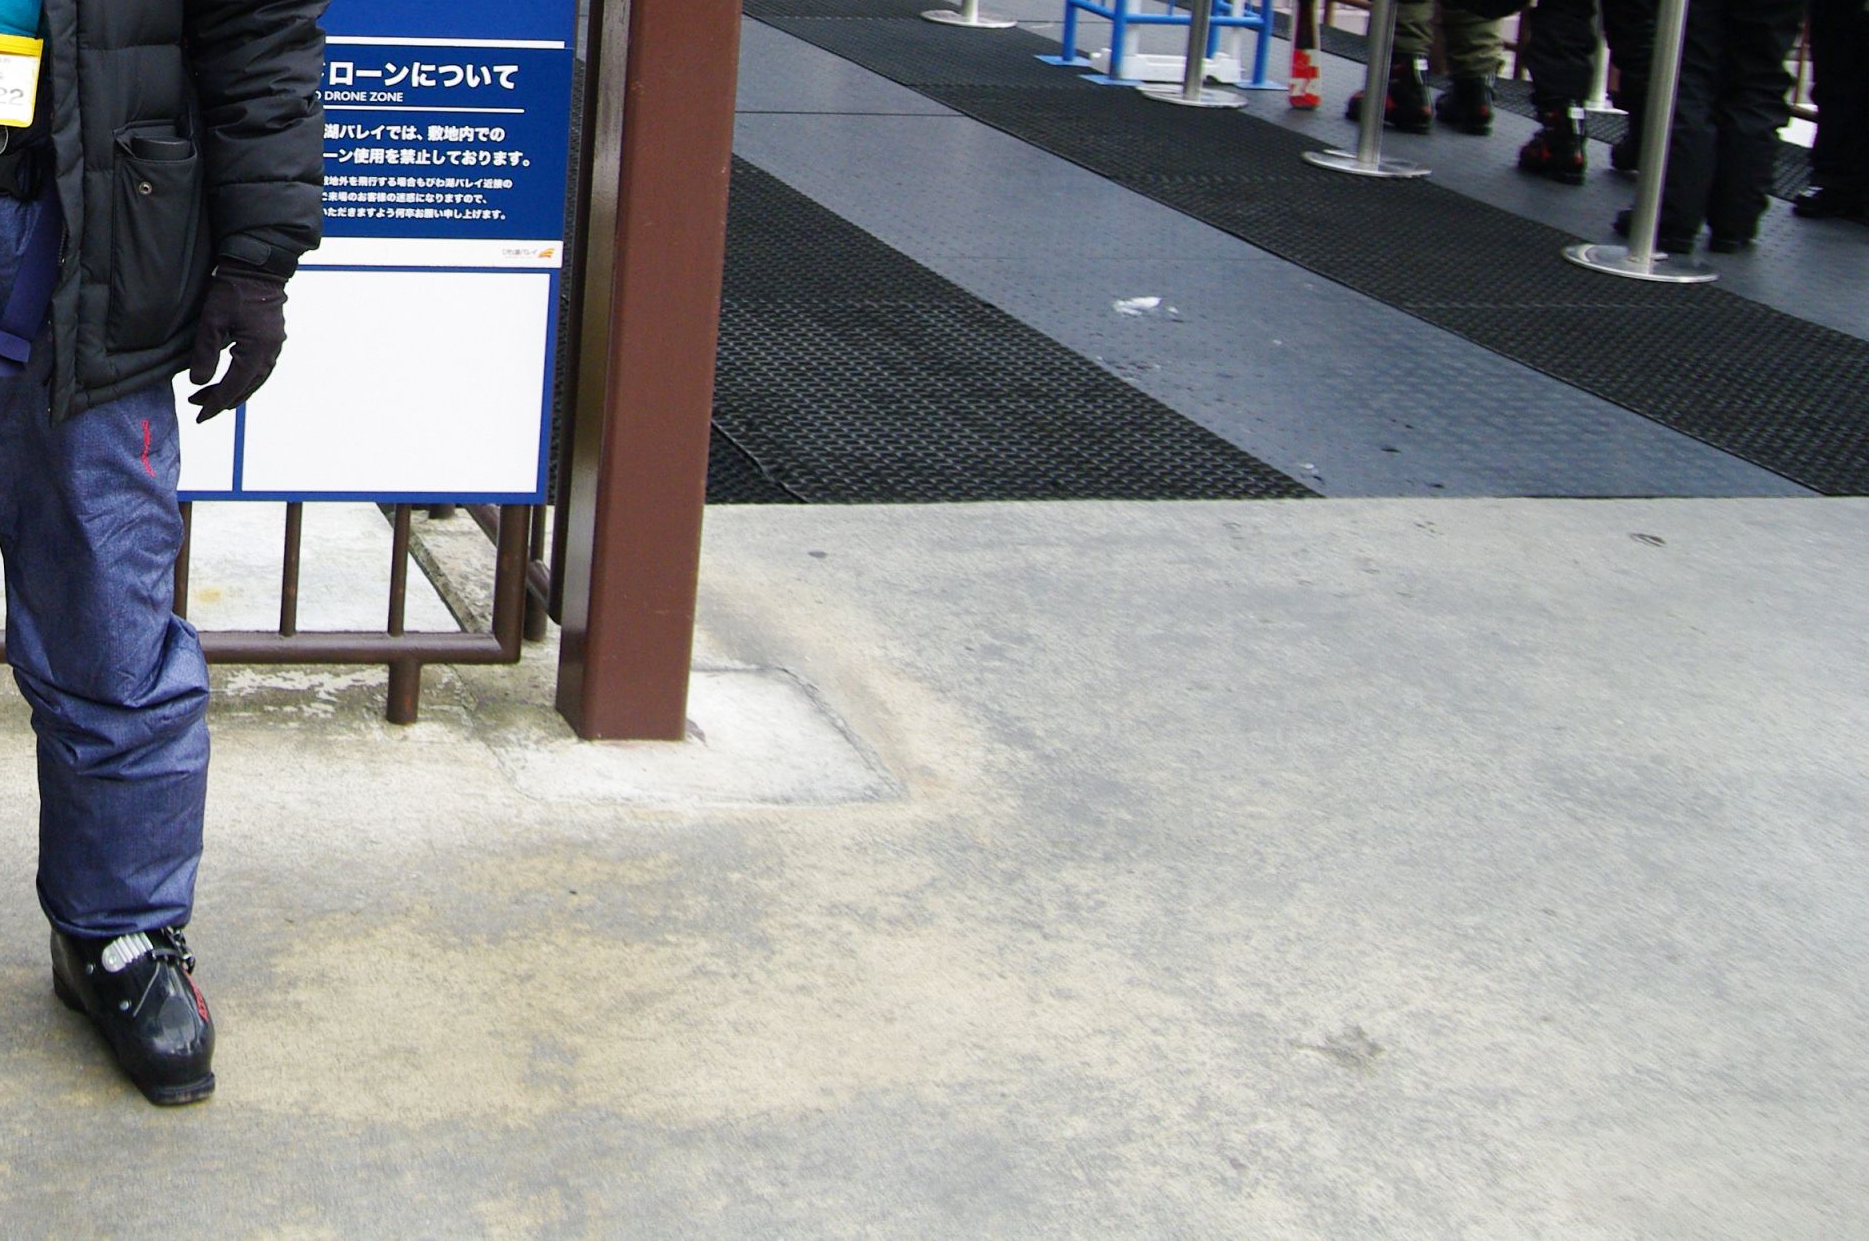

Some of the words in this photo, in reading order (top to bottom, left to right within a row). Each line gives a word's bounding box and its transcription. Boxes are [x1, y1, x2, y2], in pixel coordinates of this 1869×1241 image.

[321, 62, 519, 90] ローンについて
[324, 90, 368, 102] DRONE
[369, 91, 404, 103] ZONE
